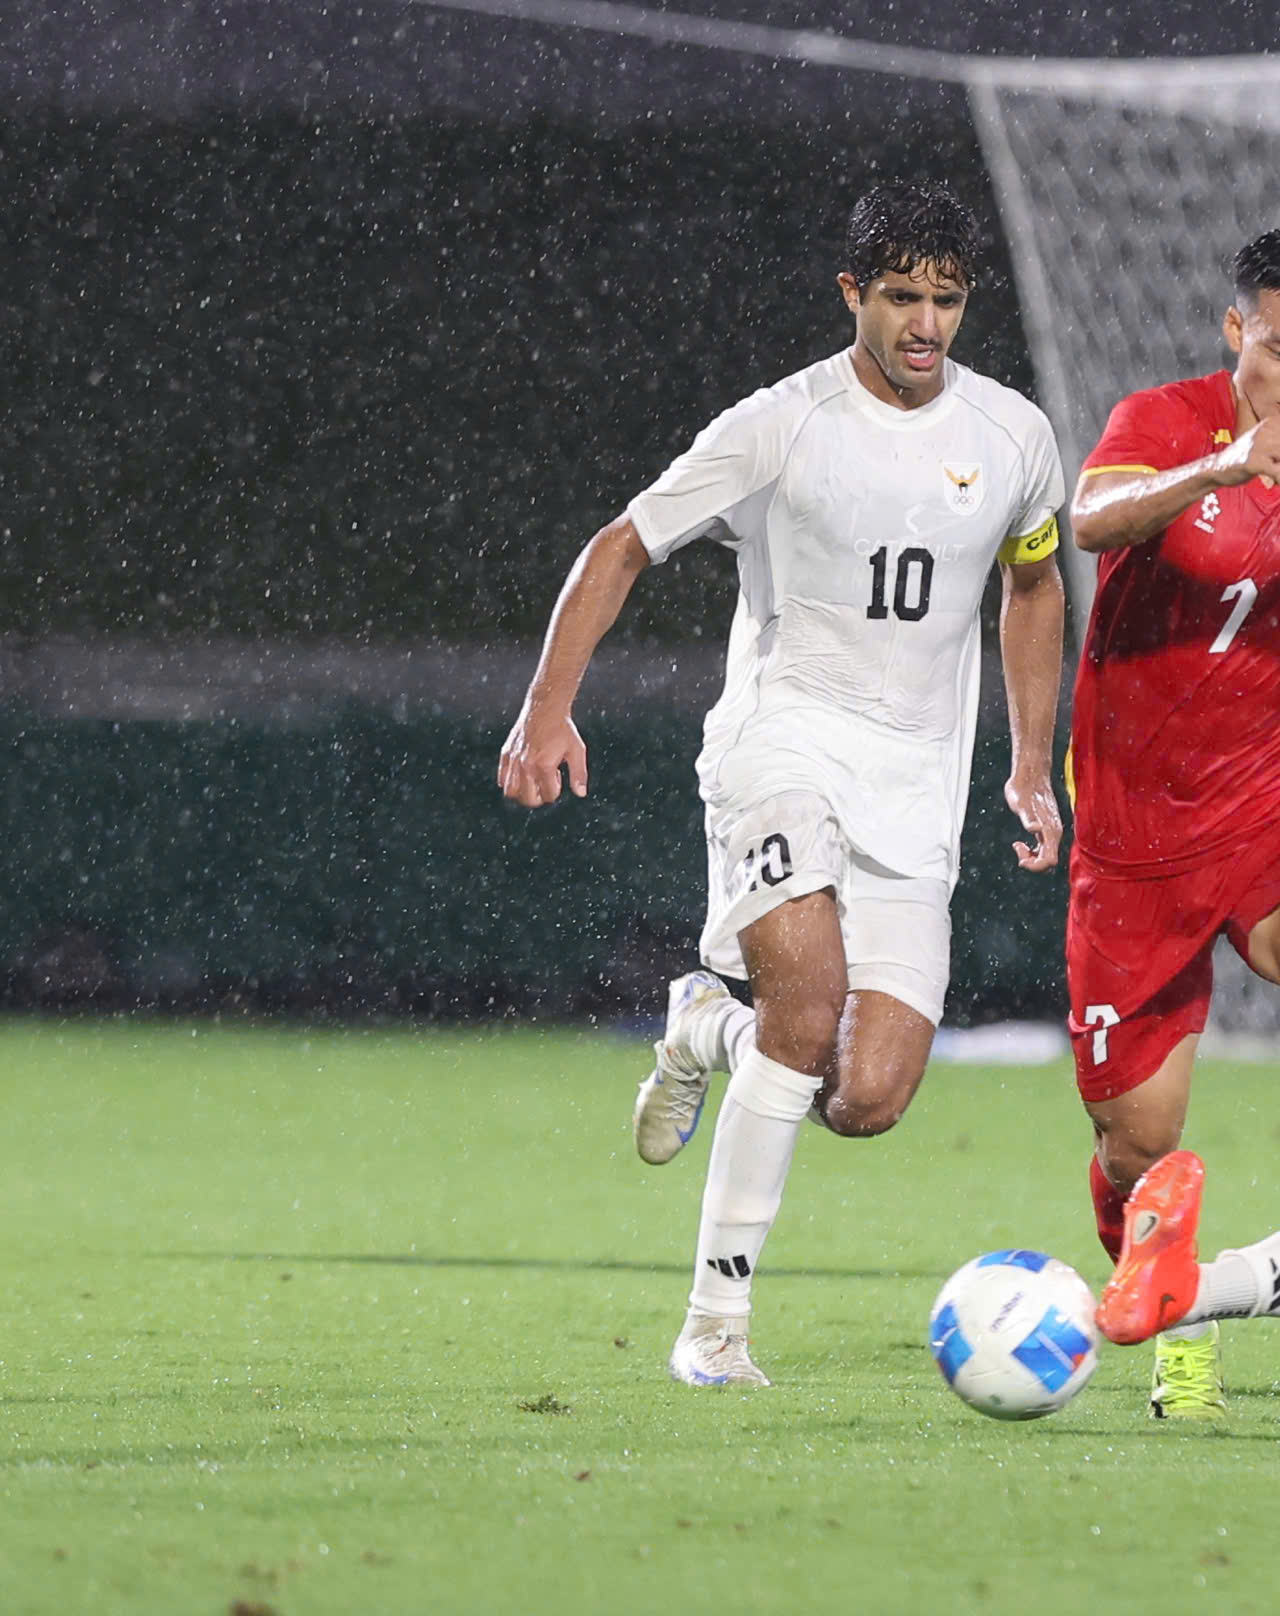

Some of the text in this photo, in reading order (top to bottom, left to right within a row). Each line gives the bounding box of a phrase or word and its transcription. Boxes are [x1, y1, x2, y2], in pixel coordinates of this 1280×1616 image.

[867, 546, 934, 621] 10
[1208, 577, 1258, 653] 7
[1084, 1004, 1120, 1066] 7
